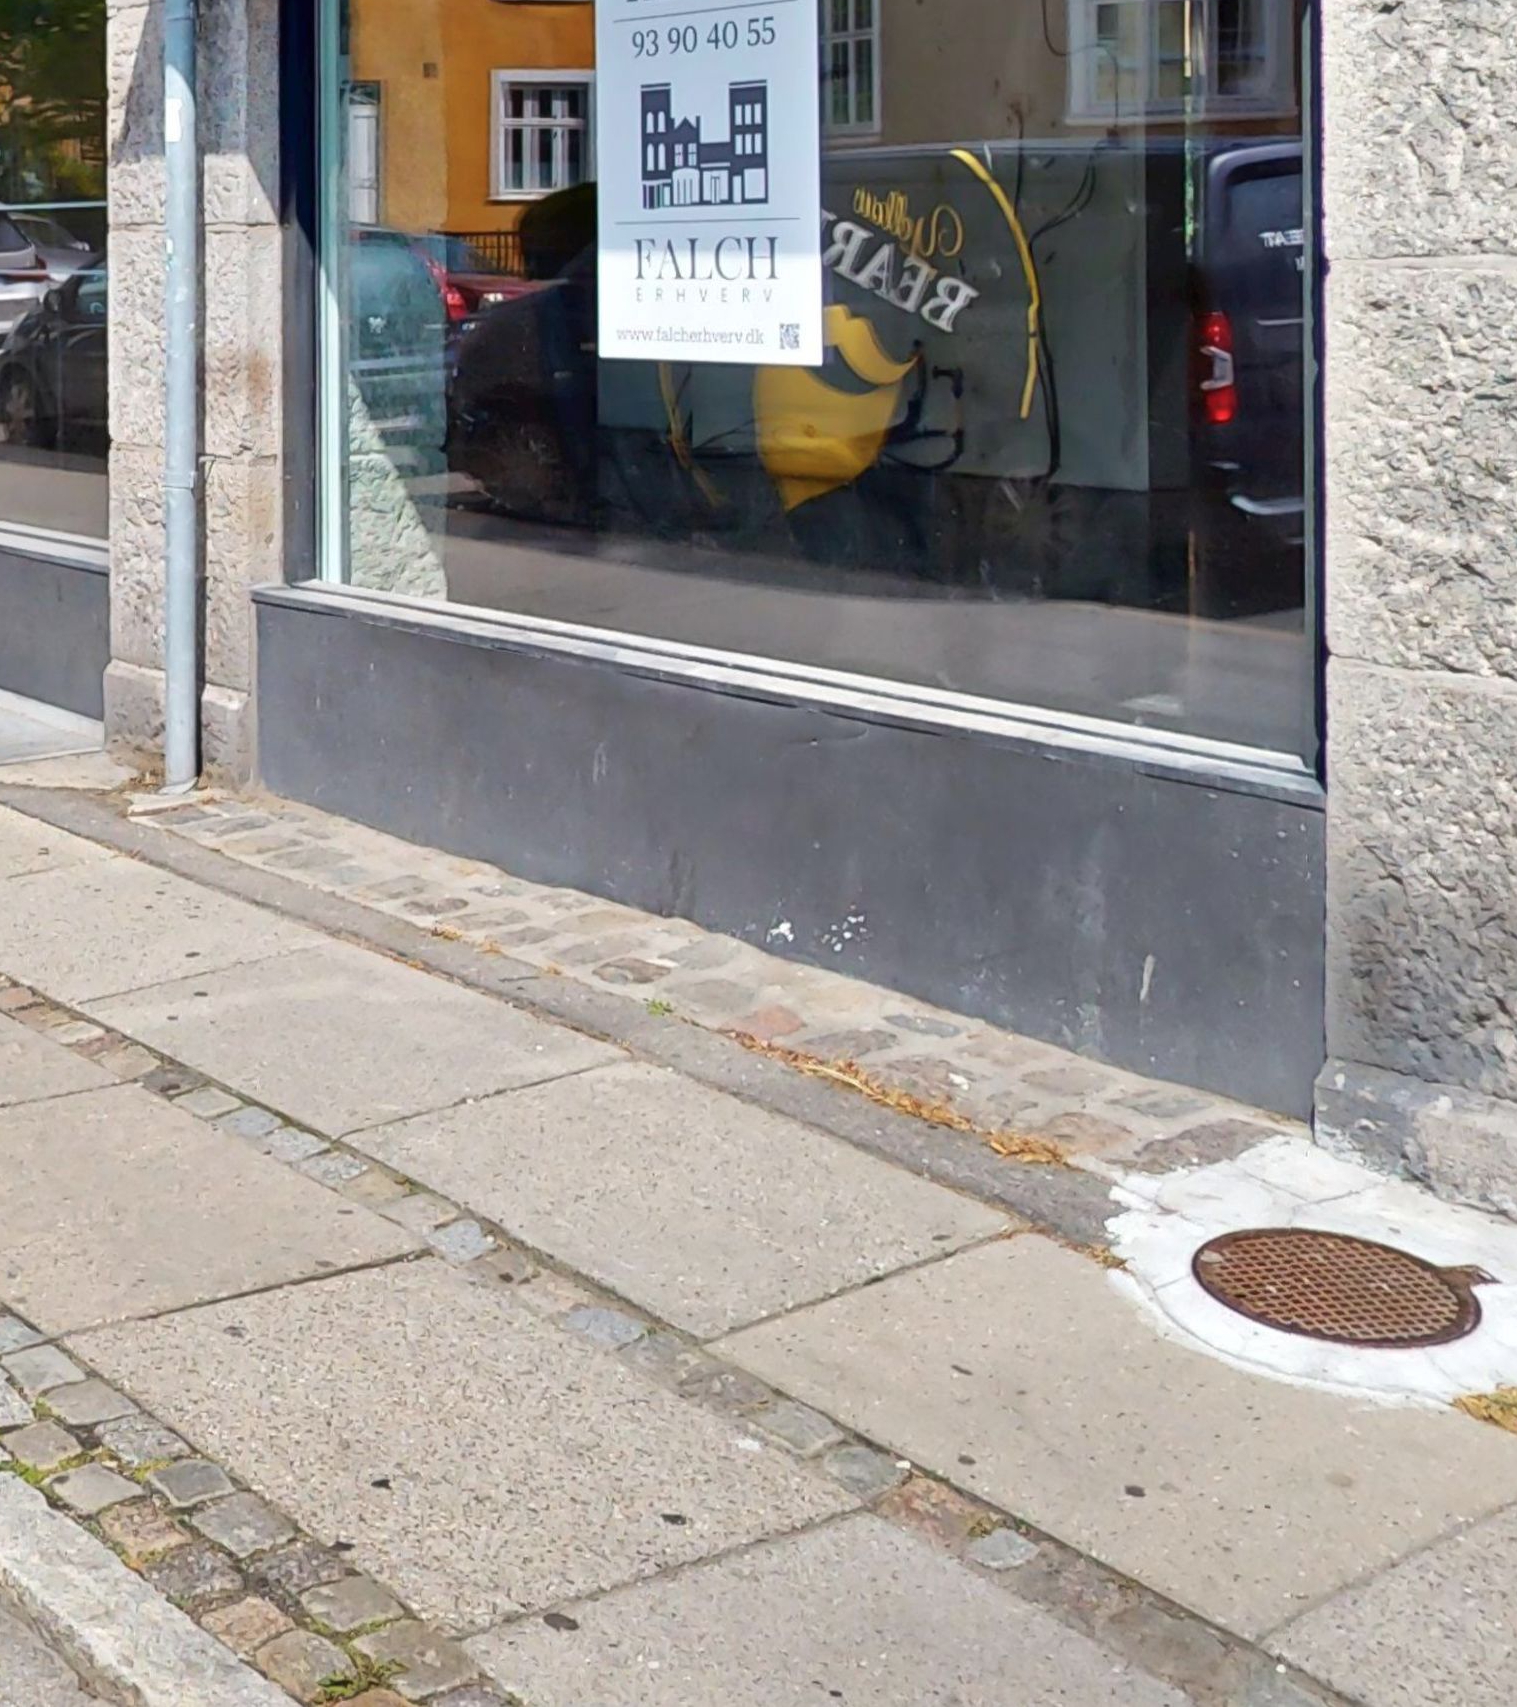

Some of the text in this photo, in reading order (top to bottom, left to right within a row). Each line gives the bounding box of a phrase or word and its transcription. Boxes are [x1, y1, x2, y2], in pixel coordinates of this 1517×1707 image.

[632, 16, 776, 59] 93 90 40 55
[633, 236, 780, 281] FALCH
[635, 287, 774, 303] ERHVERV
[615, 327, 765, 345] www.falcherhverv.dk
